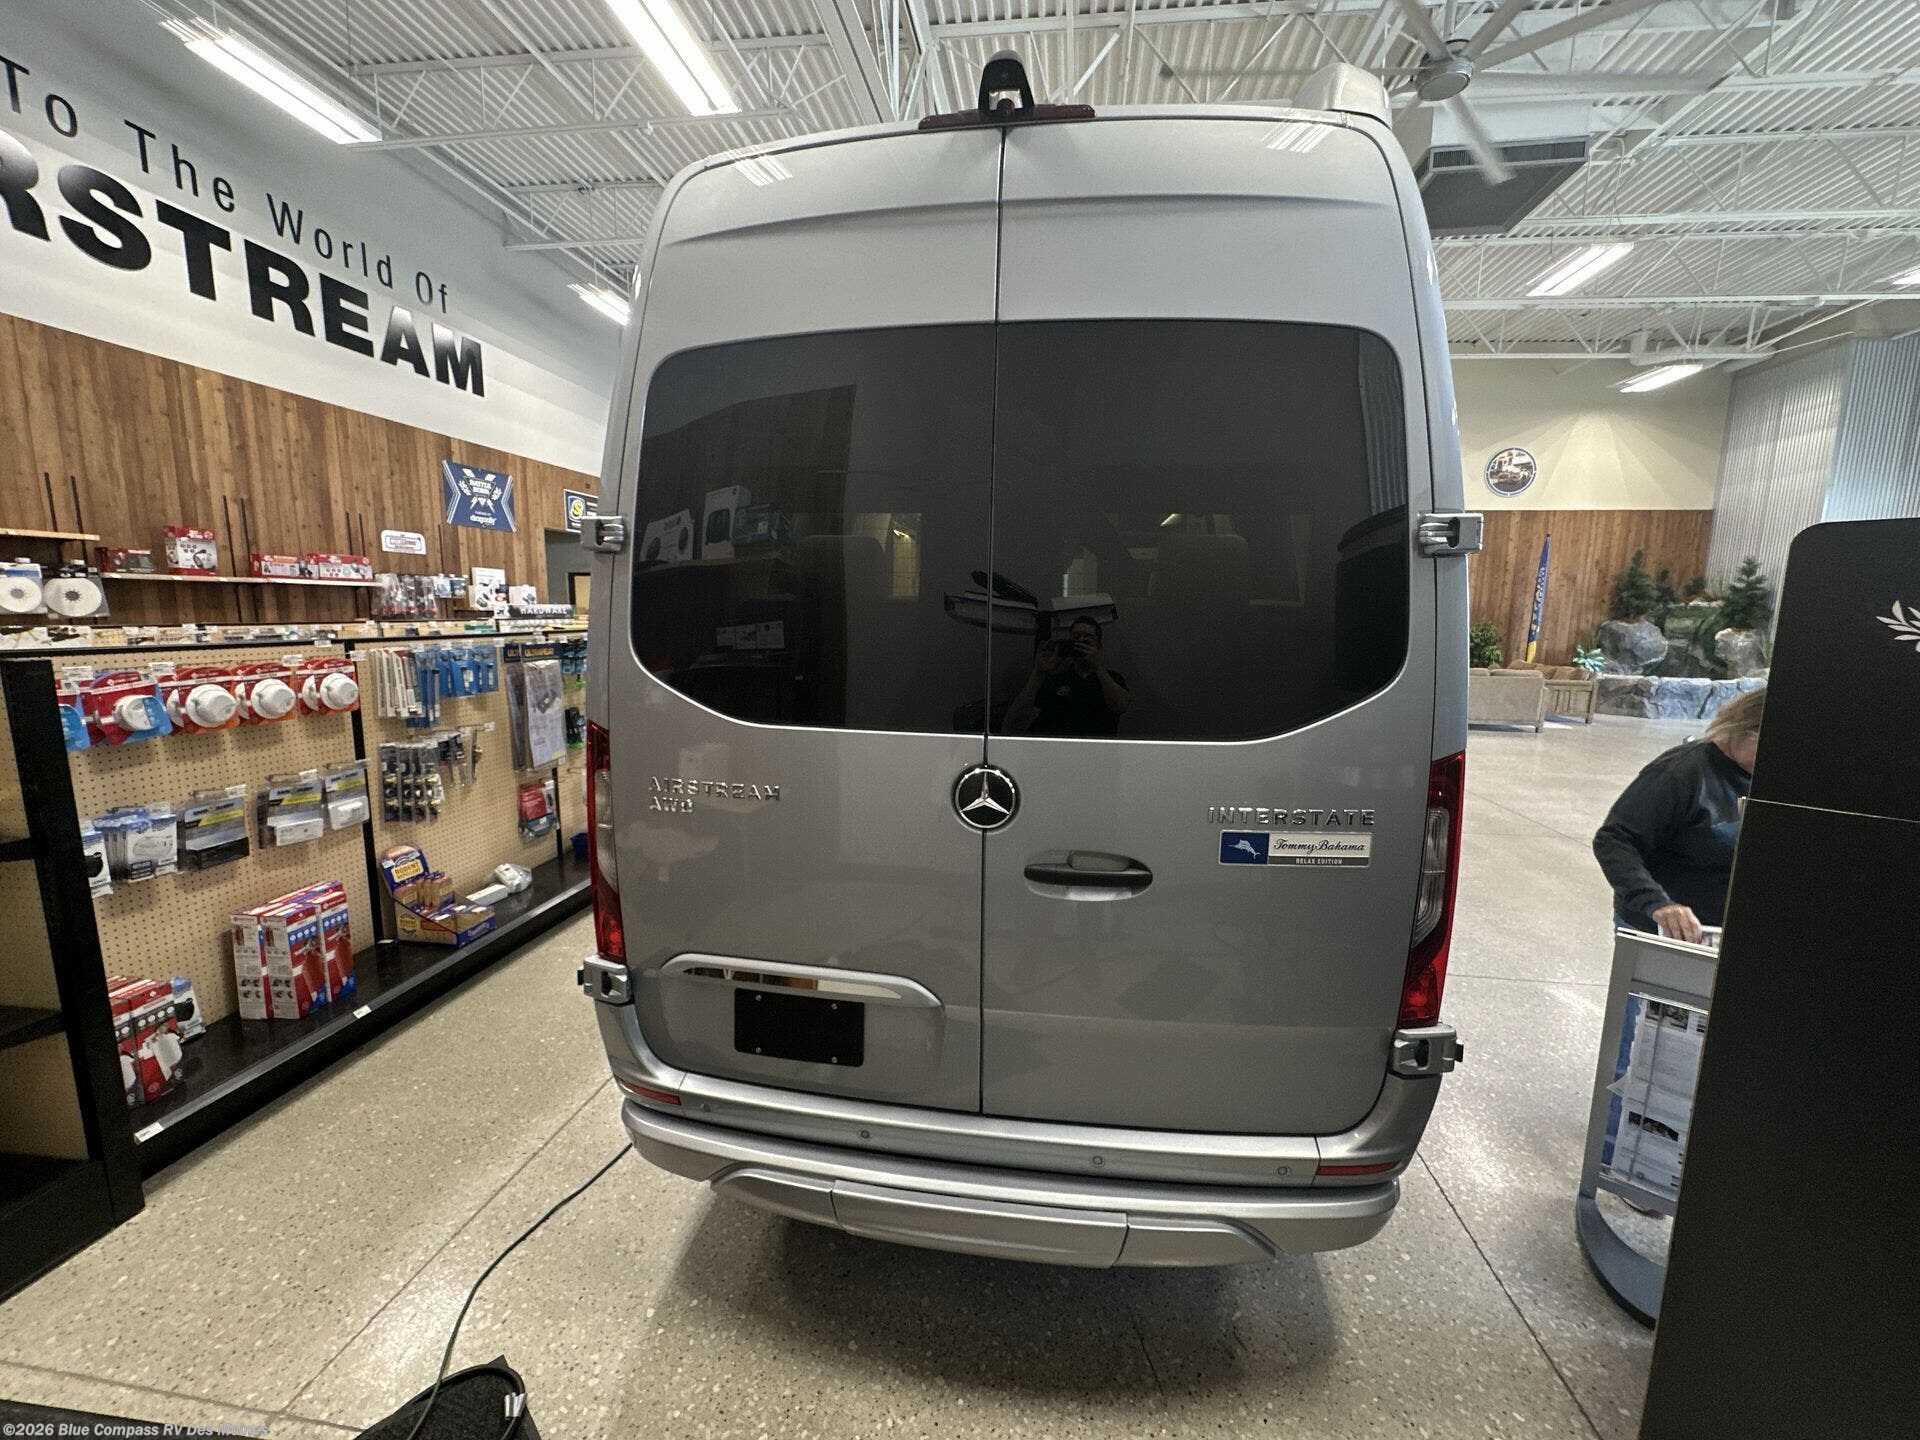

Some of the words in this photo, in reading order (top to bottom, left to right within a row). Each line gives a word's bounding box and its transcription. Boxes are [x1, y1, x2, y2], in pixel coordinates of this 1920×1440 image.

[0, 55, 78, 138] To
[124, 119, 236, 213] The
[267, 193, 394, 289] World
[415, 271, 449, 314] Of
[648, 776, 780, 801] AIRSTREAM
[648, 796, 693, 813] AWD
[1207, 806, 1376, 826] INTERSTATE
[1273, 838, 1316, 854] Tommy
[1315, 838, 1366, 852] Bahama
[1295, 857, 1316, 865] RELAX
